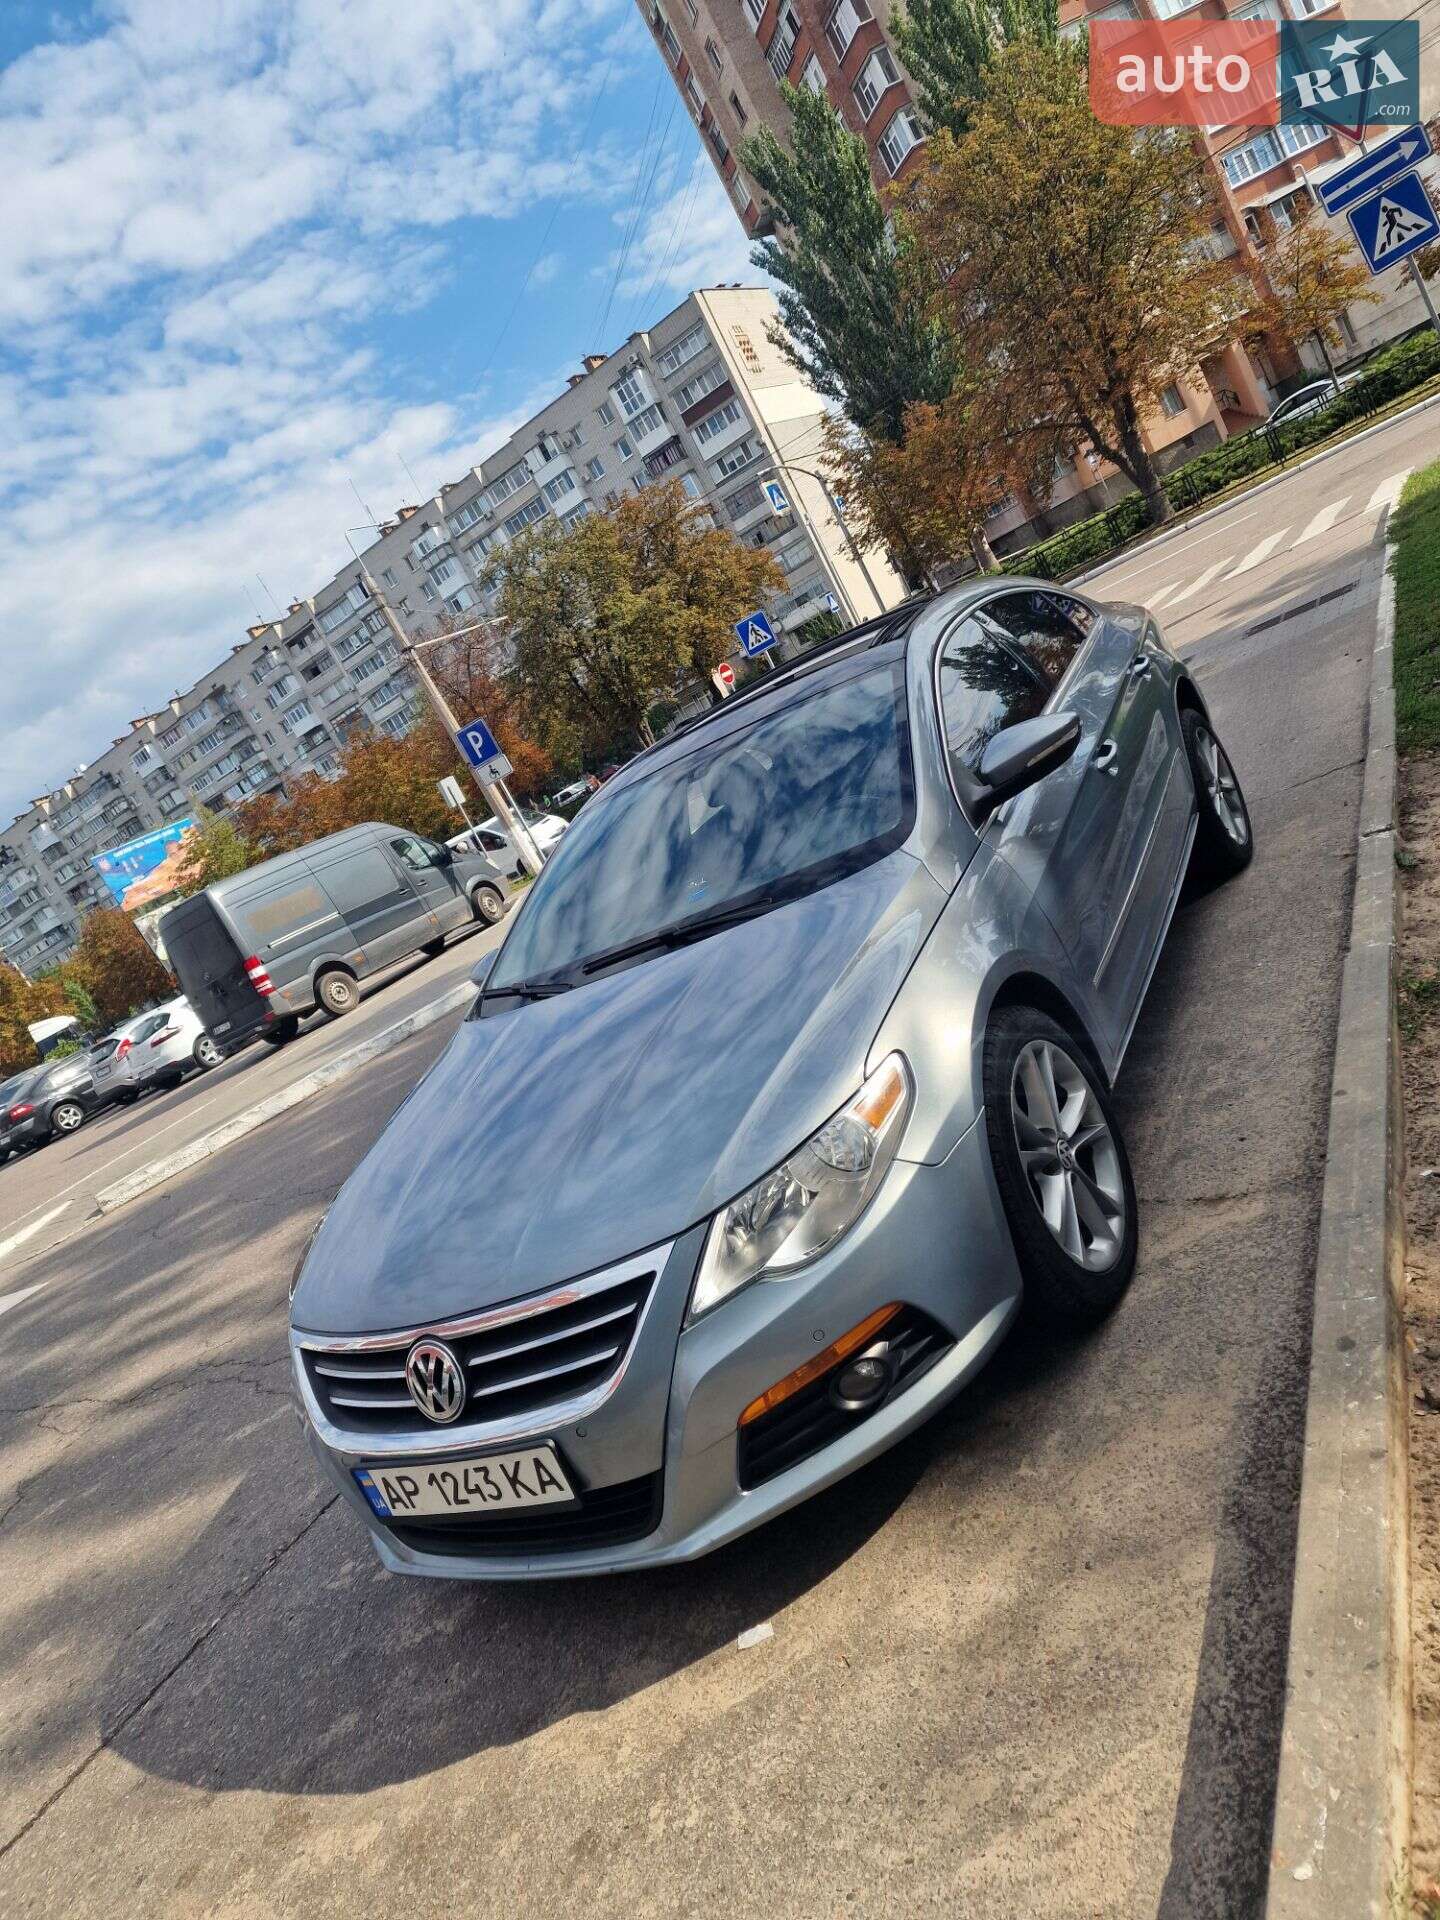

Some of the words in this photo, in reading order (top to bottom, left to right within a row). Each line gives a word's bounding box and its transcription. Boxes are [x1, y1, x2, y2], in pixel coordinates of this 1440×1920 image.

[466, 731, 483, 759] P
[381, 1475, 419, 1509] AP
[427, 1466, 503, 1506] 1243
[499, 1457, 565, 1498] KA
